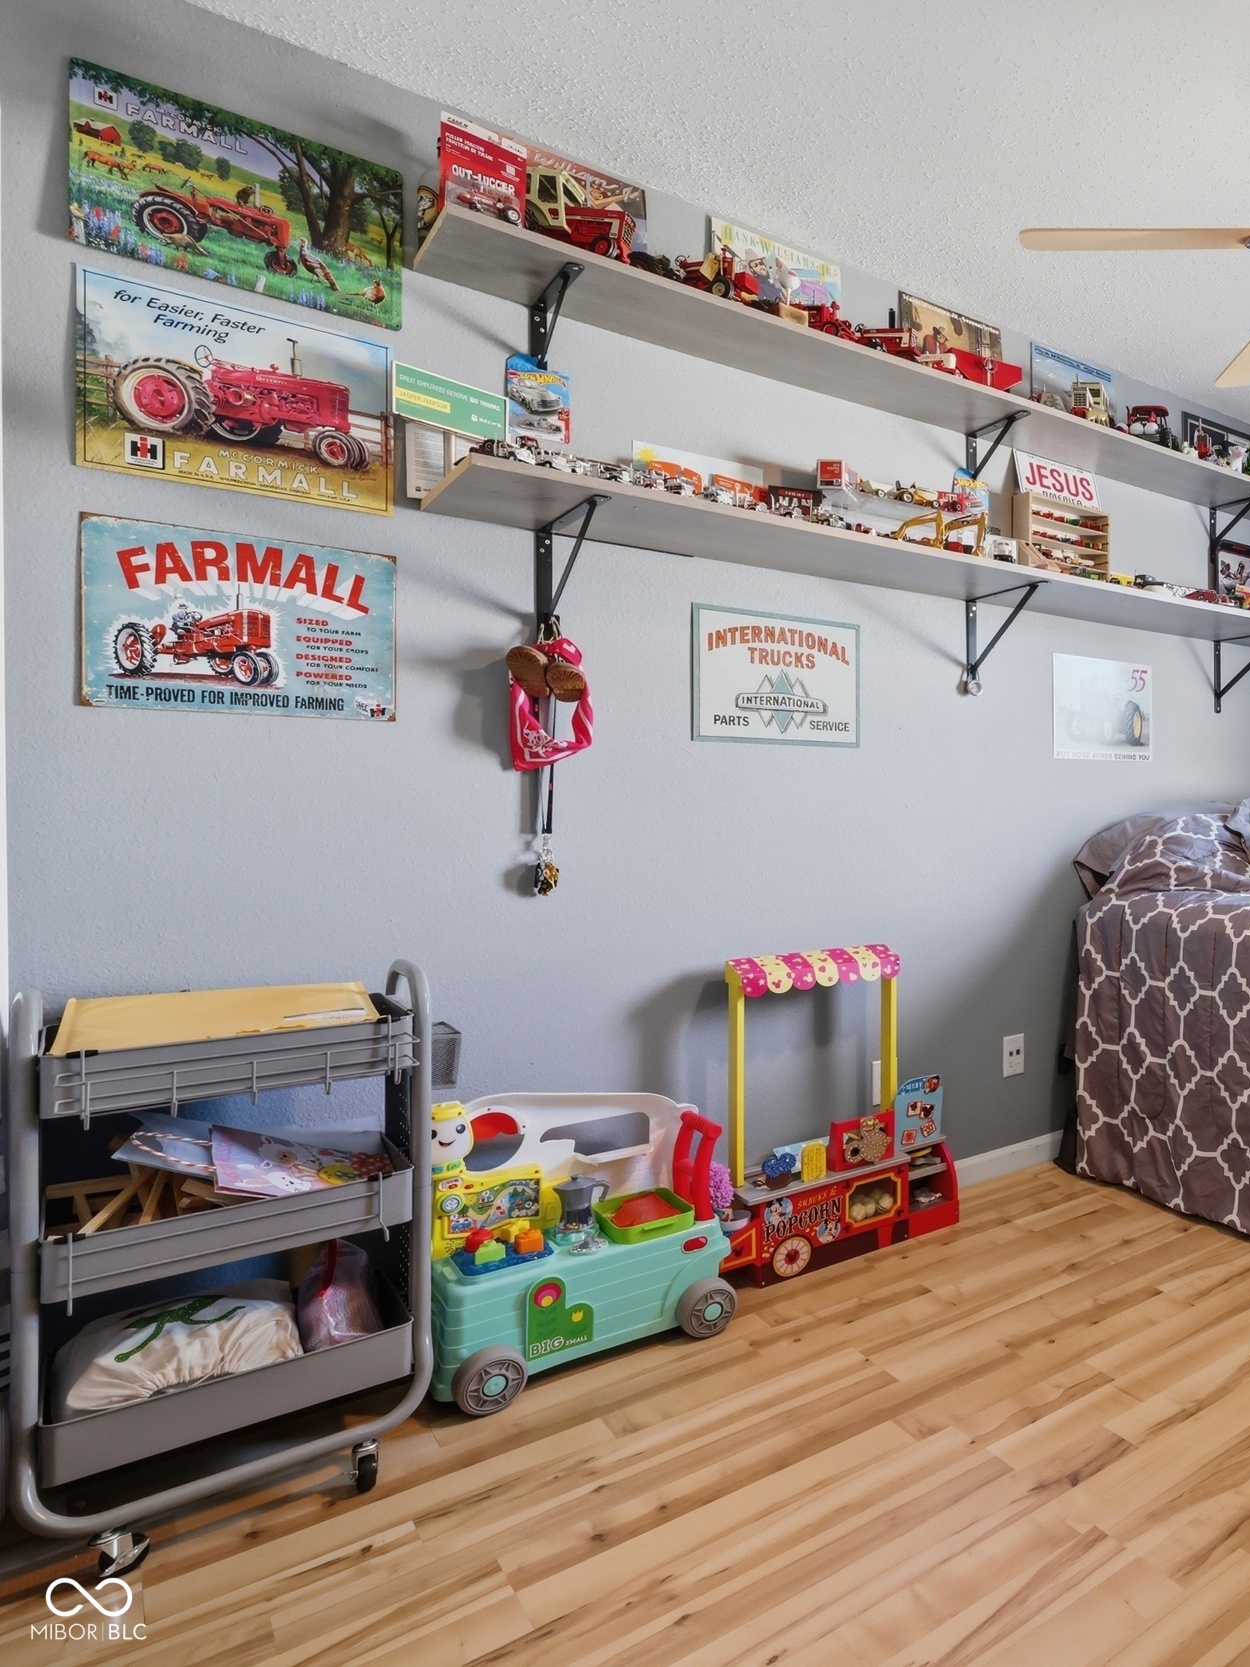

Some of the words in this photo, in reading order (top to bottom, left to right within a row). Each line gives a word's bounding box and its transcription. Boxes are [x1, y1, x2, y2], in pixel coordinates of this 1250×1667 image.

[126, 102, 248, 155] FARMALL
[112, 289, 142, 303] for
[146, 297, 204, 321] Easier,
[211, 312, 266, 335] Faster
[153, 313, 230, 345] Farming
[174, 450, 359, 500] FARMALL
[1025, 462, 1094, 502] JESUS
[116, 540, 371, 614] FARMALL
[296, 617, 329, 627] SIZED
[296, 635, 353, 647] EQUIPPED
[707, 625, 850, 666] INTERNATIONAL
[295, 653, 352, 664] DESIGNED
[747, 646, 816, 670] TRUCKS
[295, 671, 352, 681] POWERED
[1127, 669, 1148, 692] 55
[106, 684, 195, 703] TIME-PROVED
[201, 690, 225, 705] FOR
[230, 691, 290, 708] IMPROVED
[294, 695, 345, 711] FARMING
[741, 695, 820, 710] INTERNATIONAL
[713, 714, 750, 727] PARTS
[809, 720, 850, 732] SERVICE
[797, 1190, 827, 1209] SNACKS
[763, 1196, 843, 1243] POPCORN
[530, 1336, 564, 1358] BIG
